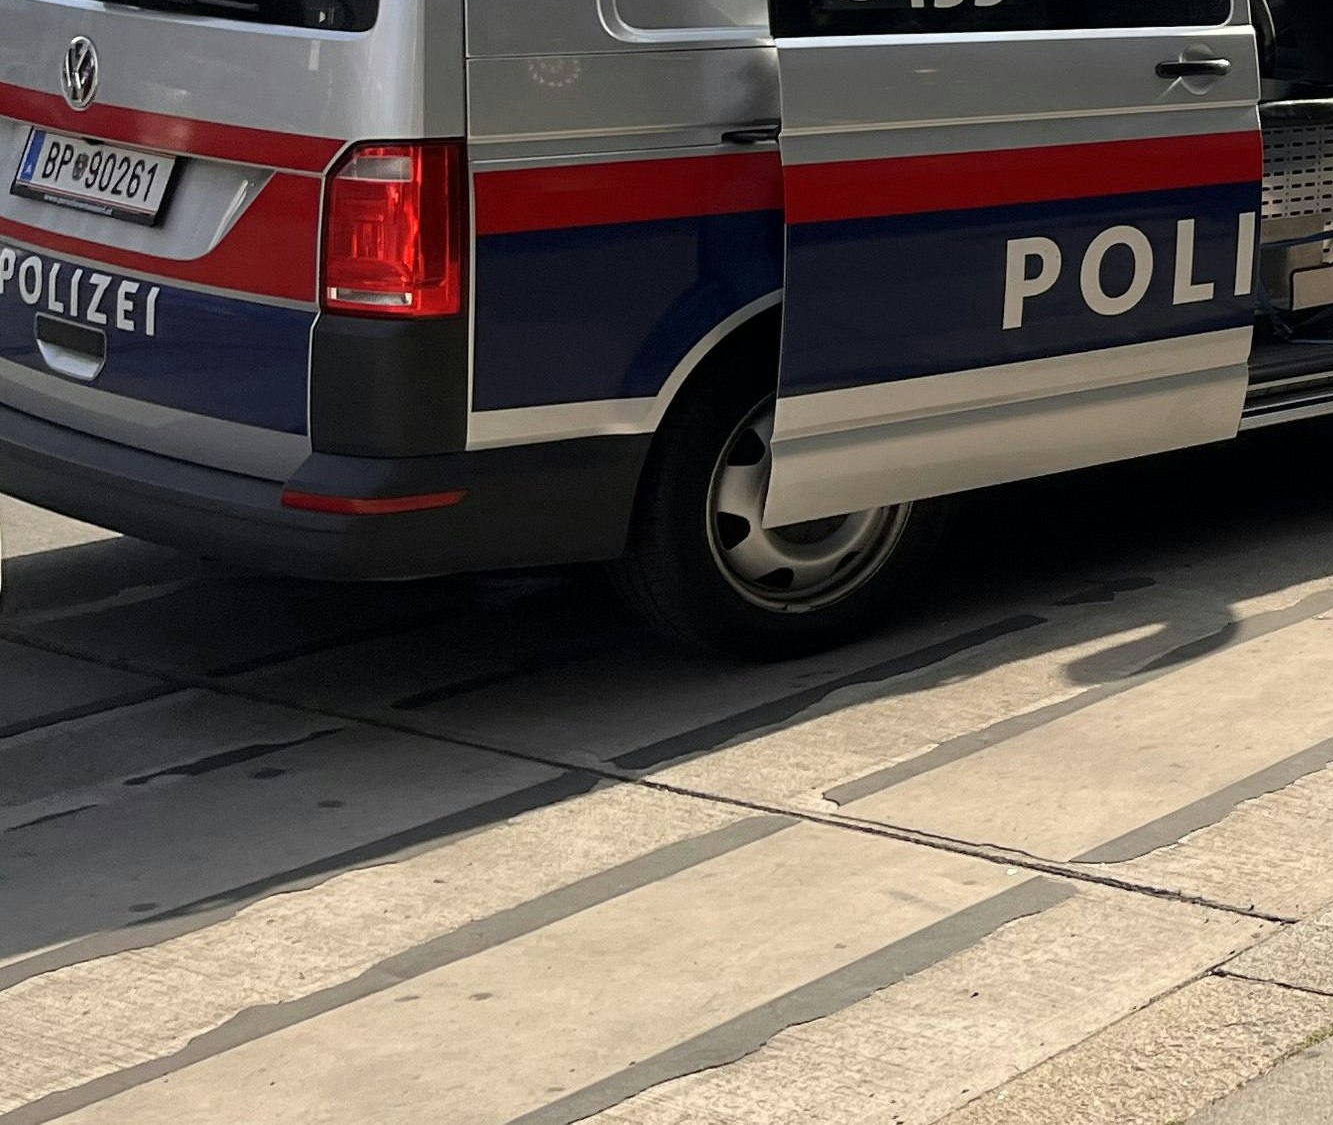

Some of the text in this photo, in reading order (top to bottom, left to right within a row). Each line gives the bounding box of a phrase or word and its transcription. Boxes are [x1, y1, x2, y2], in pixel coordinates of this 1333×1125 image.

[41, 140, 160, 202] BP 90261
[0, 247, 161, 336] POLIZEI
[1002, 210, 1257, 330] POLI
